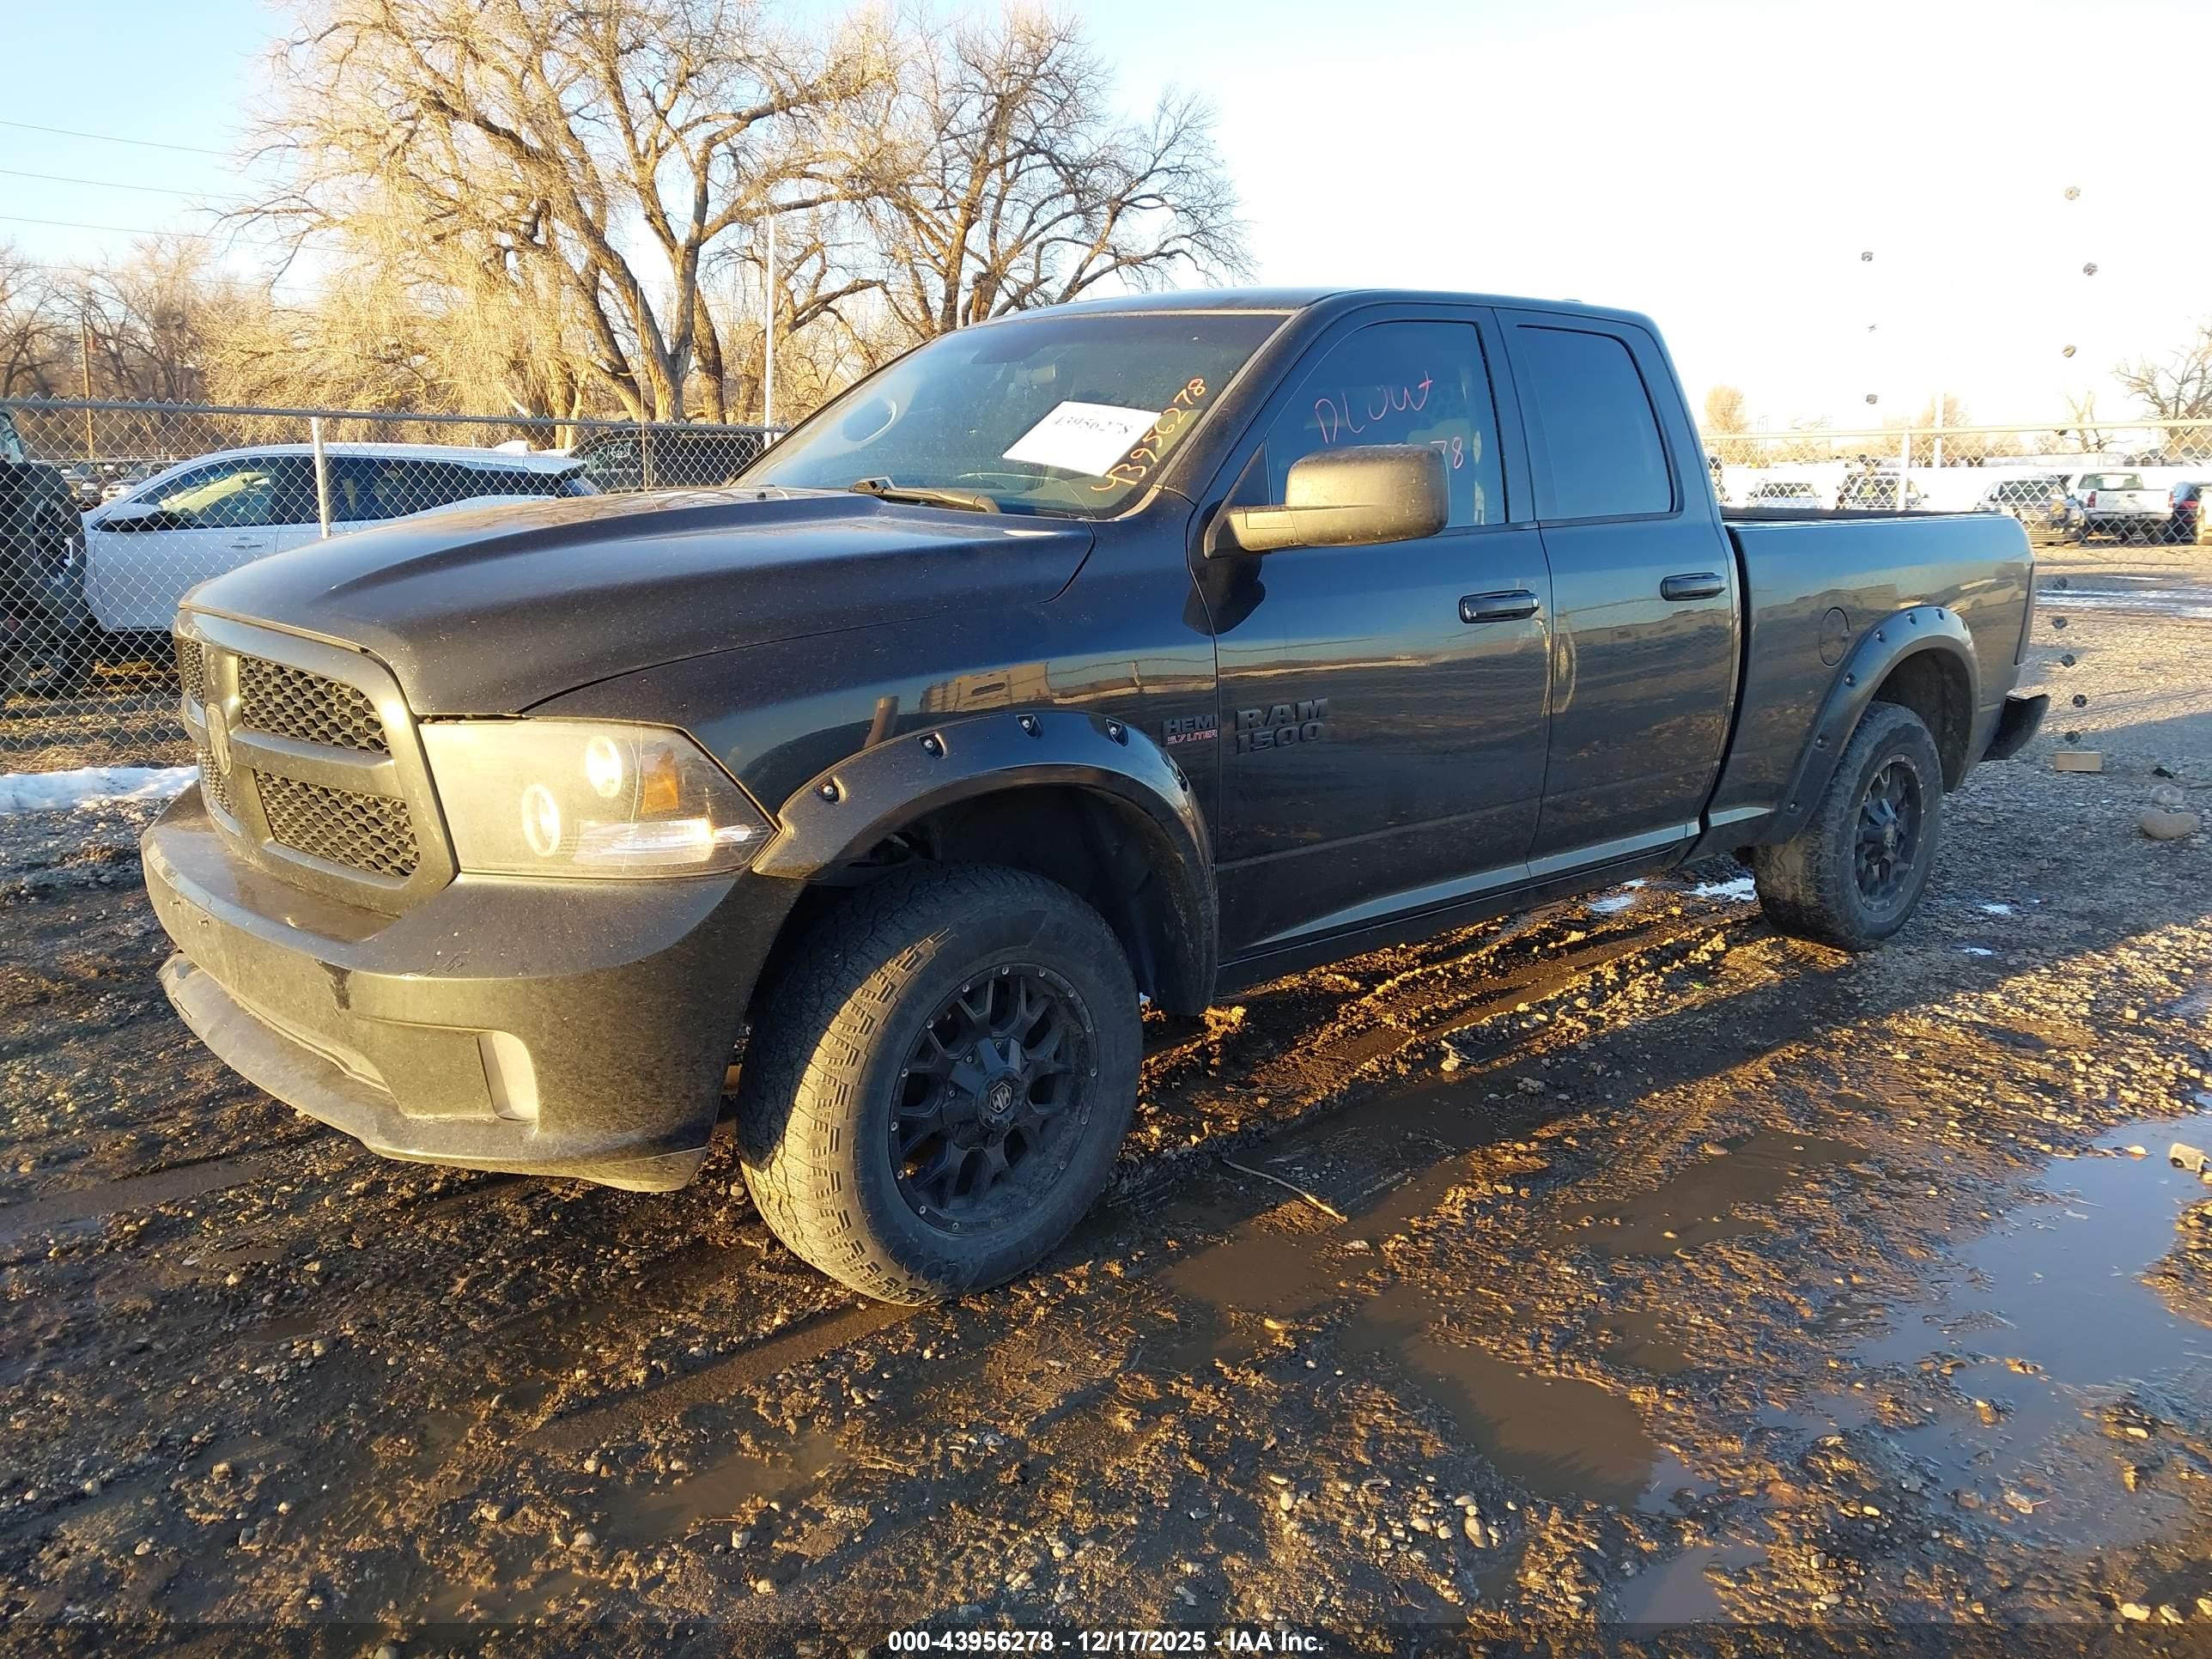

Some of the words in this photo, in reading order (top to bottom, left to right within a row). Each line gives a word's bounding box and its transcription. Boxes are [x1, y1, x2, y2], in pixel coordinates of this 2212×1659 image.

[1090, 377, 1206, 491] 43956278
[1162, 714, 1219, 741] HEMI
[1235, 697, 1328, 731] RAM
[1237, 721, 1325, 756] 1500
